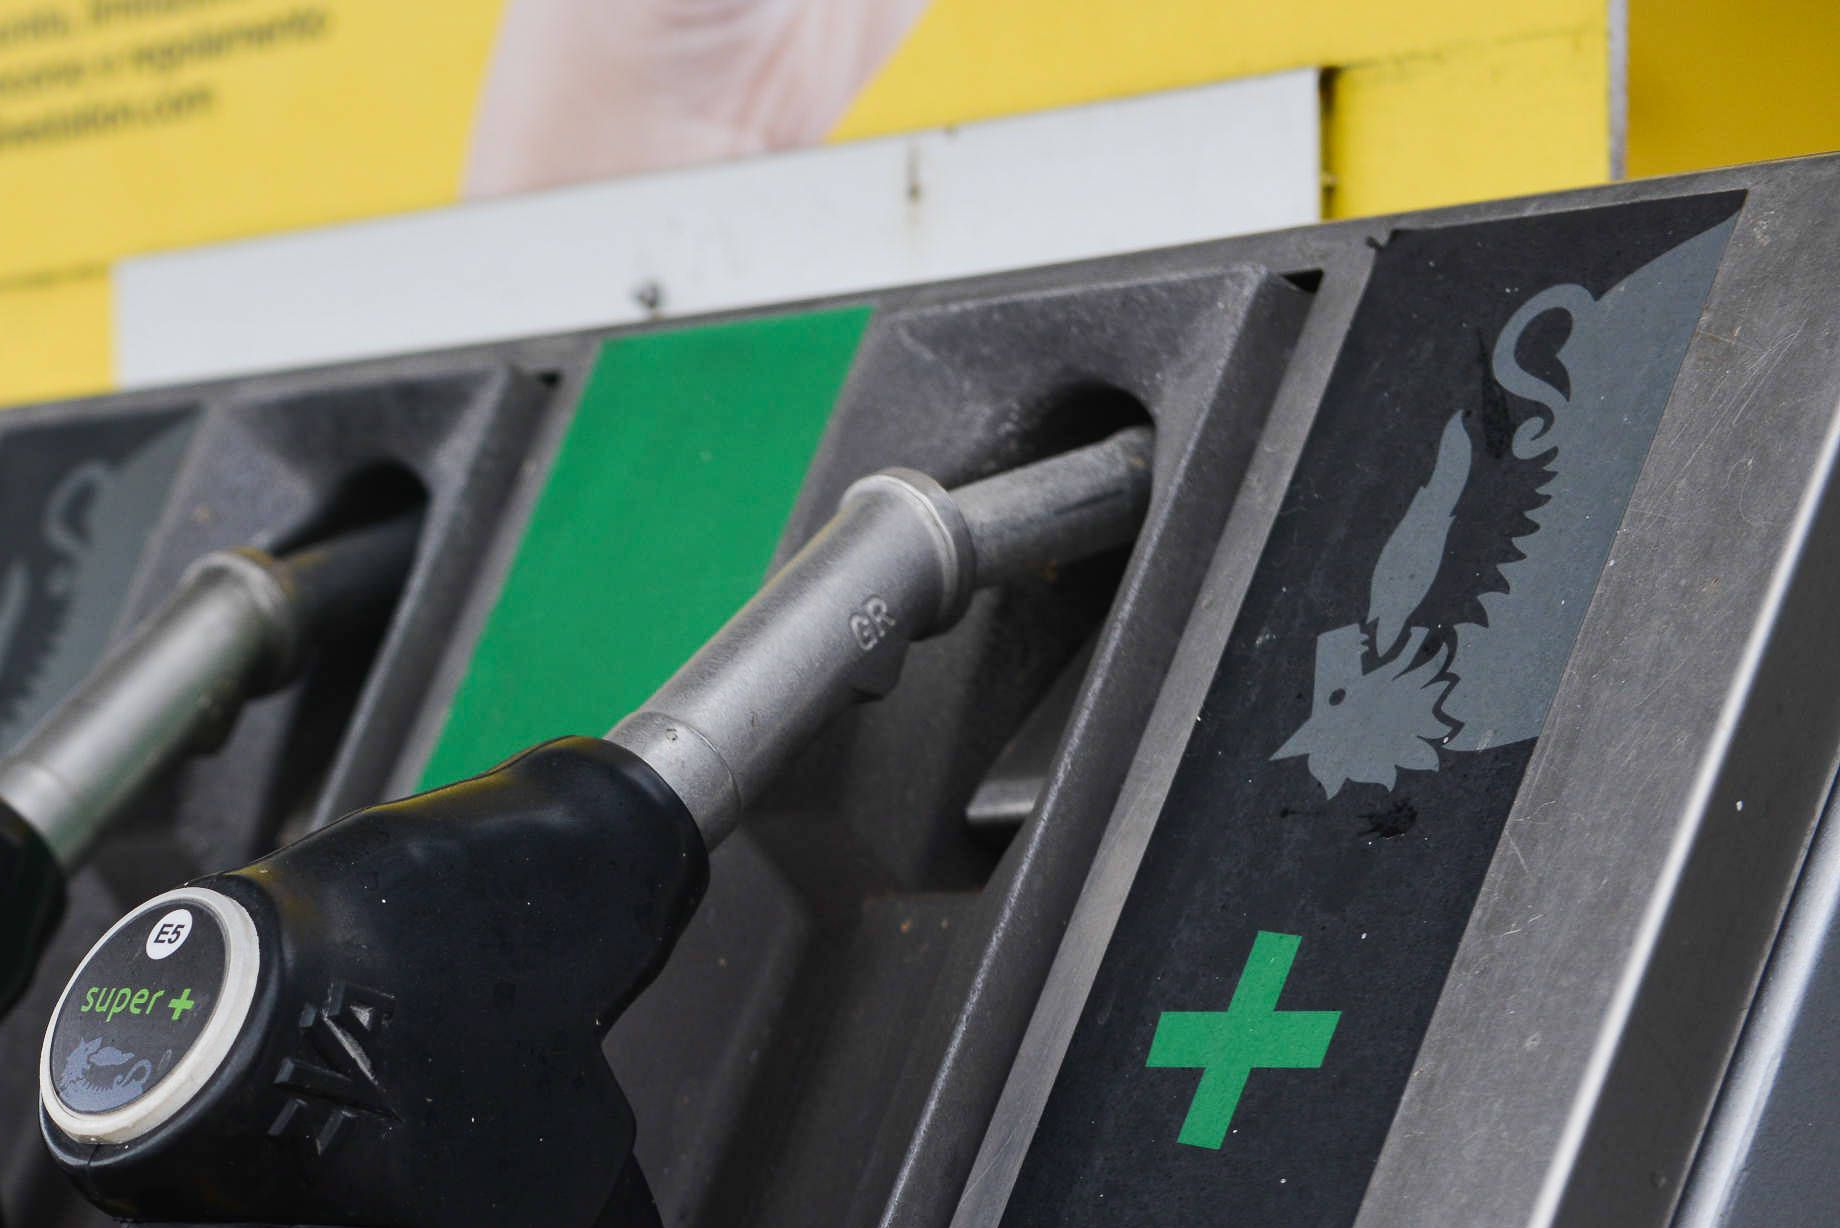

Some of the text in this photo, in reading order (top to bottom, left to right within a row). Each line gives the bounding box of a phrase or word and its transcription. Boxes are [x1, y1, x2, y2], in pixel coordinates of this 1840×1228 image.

[153, 923, 185, 945] E5
[80, 985, 166, 1023] super
[1145, 930, 1343, 1150] +
